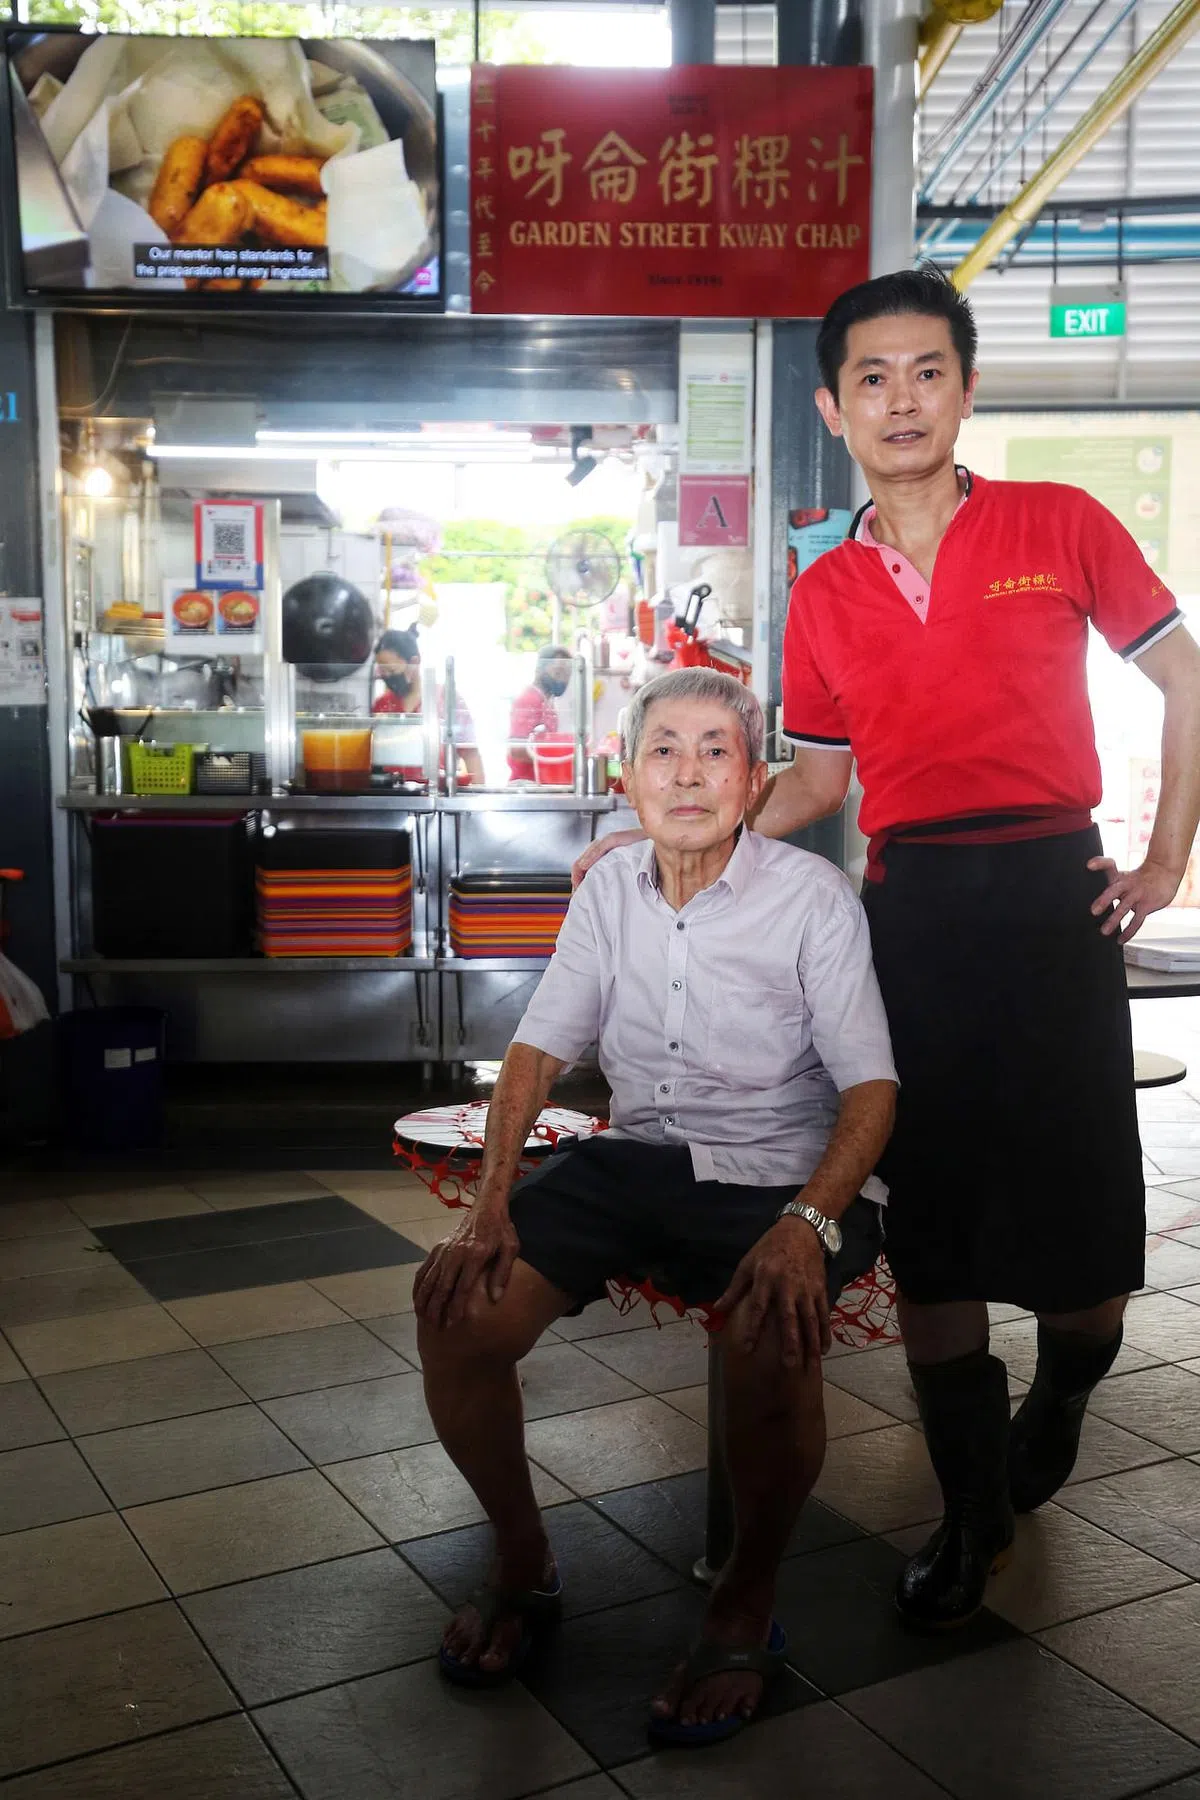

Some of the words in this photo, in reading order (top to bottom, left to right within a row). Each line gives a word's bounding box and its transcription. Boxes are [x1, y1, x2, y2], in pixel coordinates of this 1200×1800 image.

[509, 221, 612, 247] GARDEN
[619, 221, 712, 248] STREET
[719, 222, 788, 248] KWAY
[795, 223, 862, 249] CHAP
[149, 247, 172, 259] Our
[173, 249, 214, 260] mentor
[215, 248, 238, 260] has
[239, 249, 296, 261] standards
[297, 249, 313, 261] for
[136, 263, 155, 275] the
[157, 264, 222, 278] preparation
[223, 264, 236, 277] of
[237, 266, 268, 279] every
[271, 265, 327, 279] ingredient
[1064, 308, 1110, 335] EXIT
[696, 495, 732, 528] A
